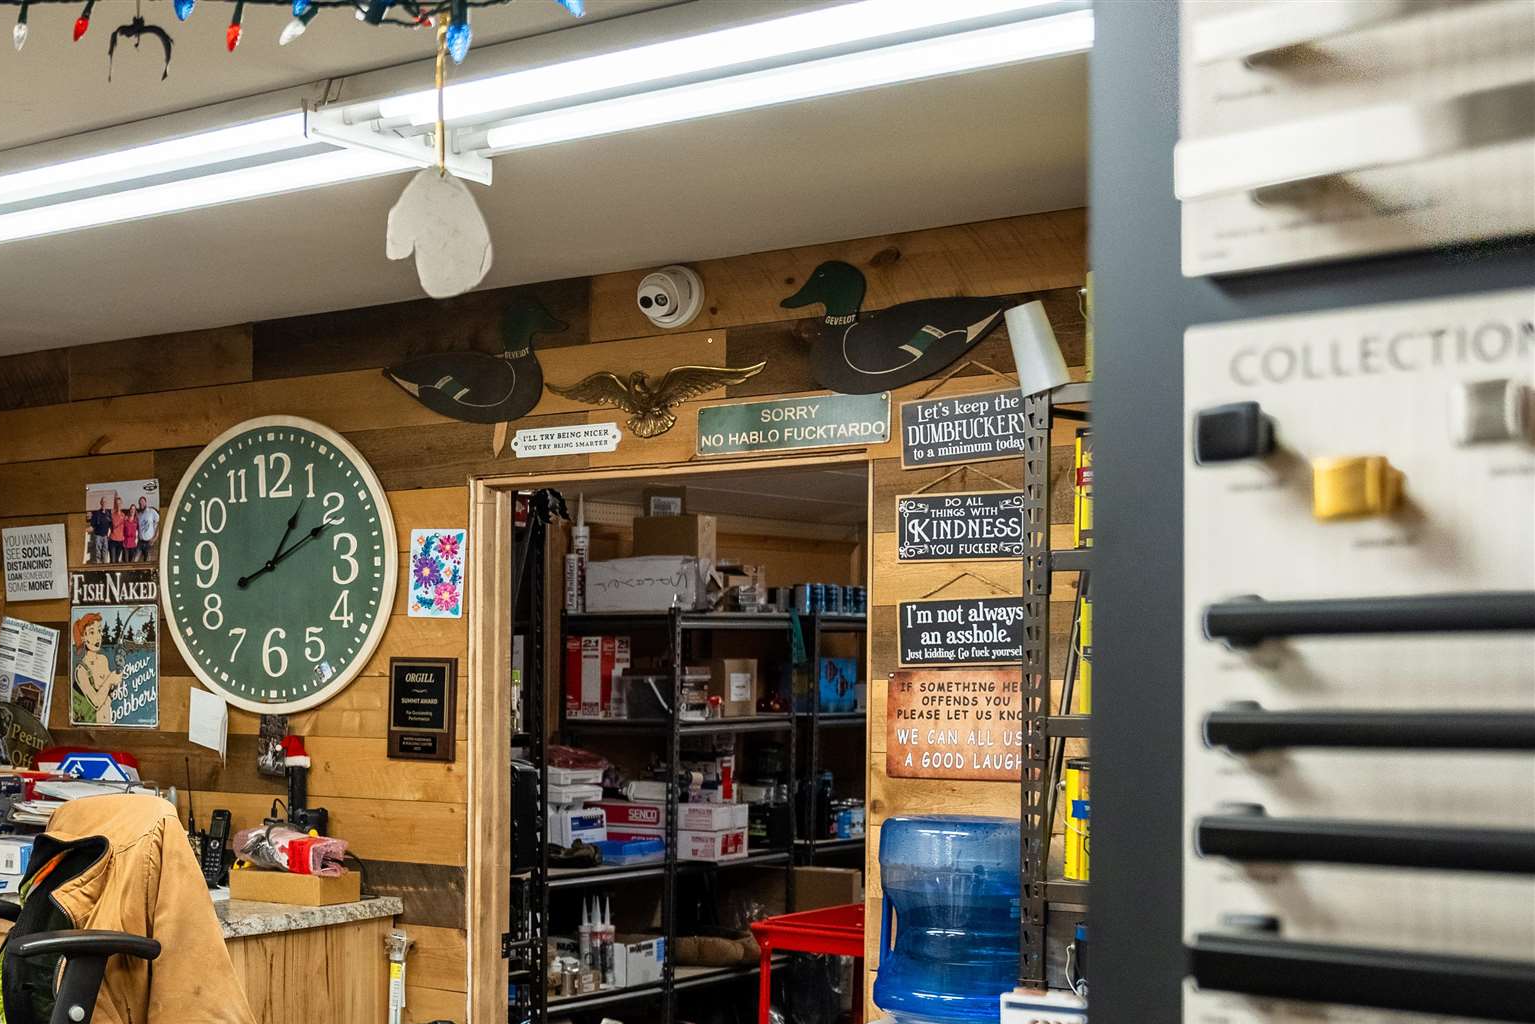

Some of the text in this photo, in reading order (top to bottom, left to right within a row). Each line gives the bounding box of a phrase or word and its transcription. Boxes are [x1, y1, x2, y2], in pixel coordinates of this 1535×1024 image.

[761, 404, 819, 422] SORRY
[918, 394, 1020, 422] Let's keep the
[557, 431, 582, 439] BEING
[584, 429, 608, 437] NICER
[702, 421, 885, 447] NO HABLO FUCKTARDO
[914, 450, 924, 460] to
[927, 449, 934, 458] a
[938, 441, 992, 457] minimum
[254, 452, 292, 498] 12
[304, 463, 316, 498] 1
[227, 468, 247, 503] 11
[322, 492, 345, 526] 2
[945, 497, 984, 506] DO ALL
[200, 497, 226, 534] 10
[930, 506, 998, 518] THINGS WITH
[4, 532, 53, 547] YOU WANNA
[908, 518, 1022, 543] KINDNESS
[22, 546, 52, 558] SOCIAL
[332, 532, 359, 585] 3
[930, 543, 998, 556] YOU FUCKER
[7, 559, 52, 571] DISTANCING?
[194, 540, 220, 589] 9
[8, 572, 22, 581] LOAN
[28, 580, 54, 590] MONEY
[72, 572, 157, 604] FISH NAKED
[202, 594, 224, 630] 8
[330, 590, 354, 628] 4
[906, 602, 1024, 628] I'm not always
[920, 623, 1012, 645] an asshole.
[228, 628, 247, 663] 7
[262, 628, 288, 678] 6
[304, 627, 326, 662] 5
[906, 649, 923, 660] Just
[958, 647, 969, 658] Go
[971, 646, 990, 658] fuck
[992, 645, 1022, 659] yoursel
[122, 656, 150, 680] Show
[406, 672, 434, 683] ORGILL
[900, 682, 1022, 693] IF SOMETHING HE
[922, 696, 1011, 706] OFFENDS YOU
[897, 710, 1022, 720] PLEASE LET US KNO
[897, 728, 1022, 746] WE CAN ALL US
[12, 750, 33, 768] Off
[905, 753, 912, 767] A
[922, 752, 964, 768] GOOD
[628, 808, 657, 822] SENCO
